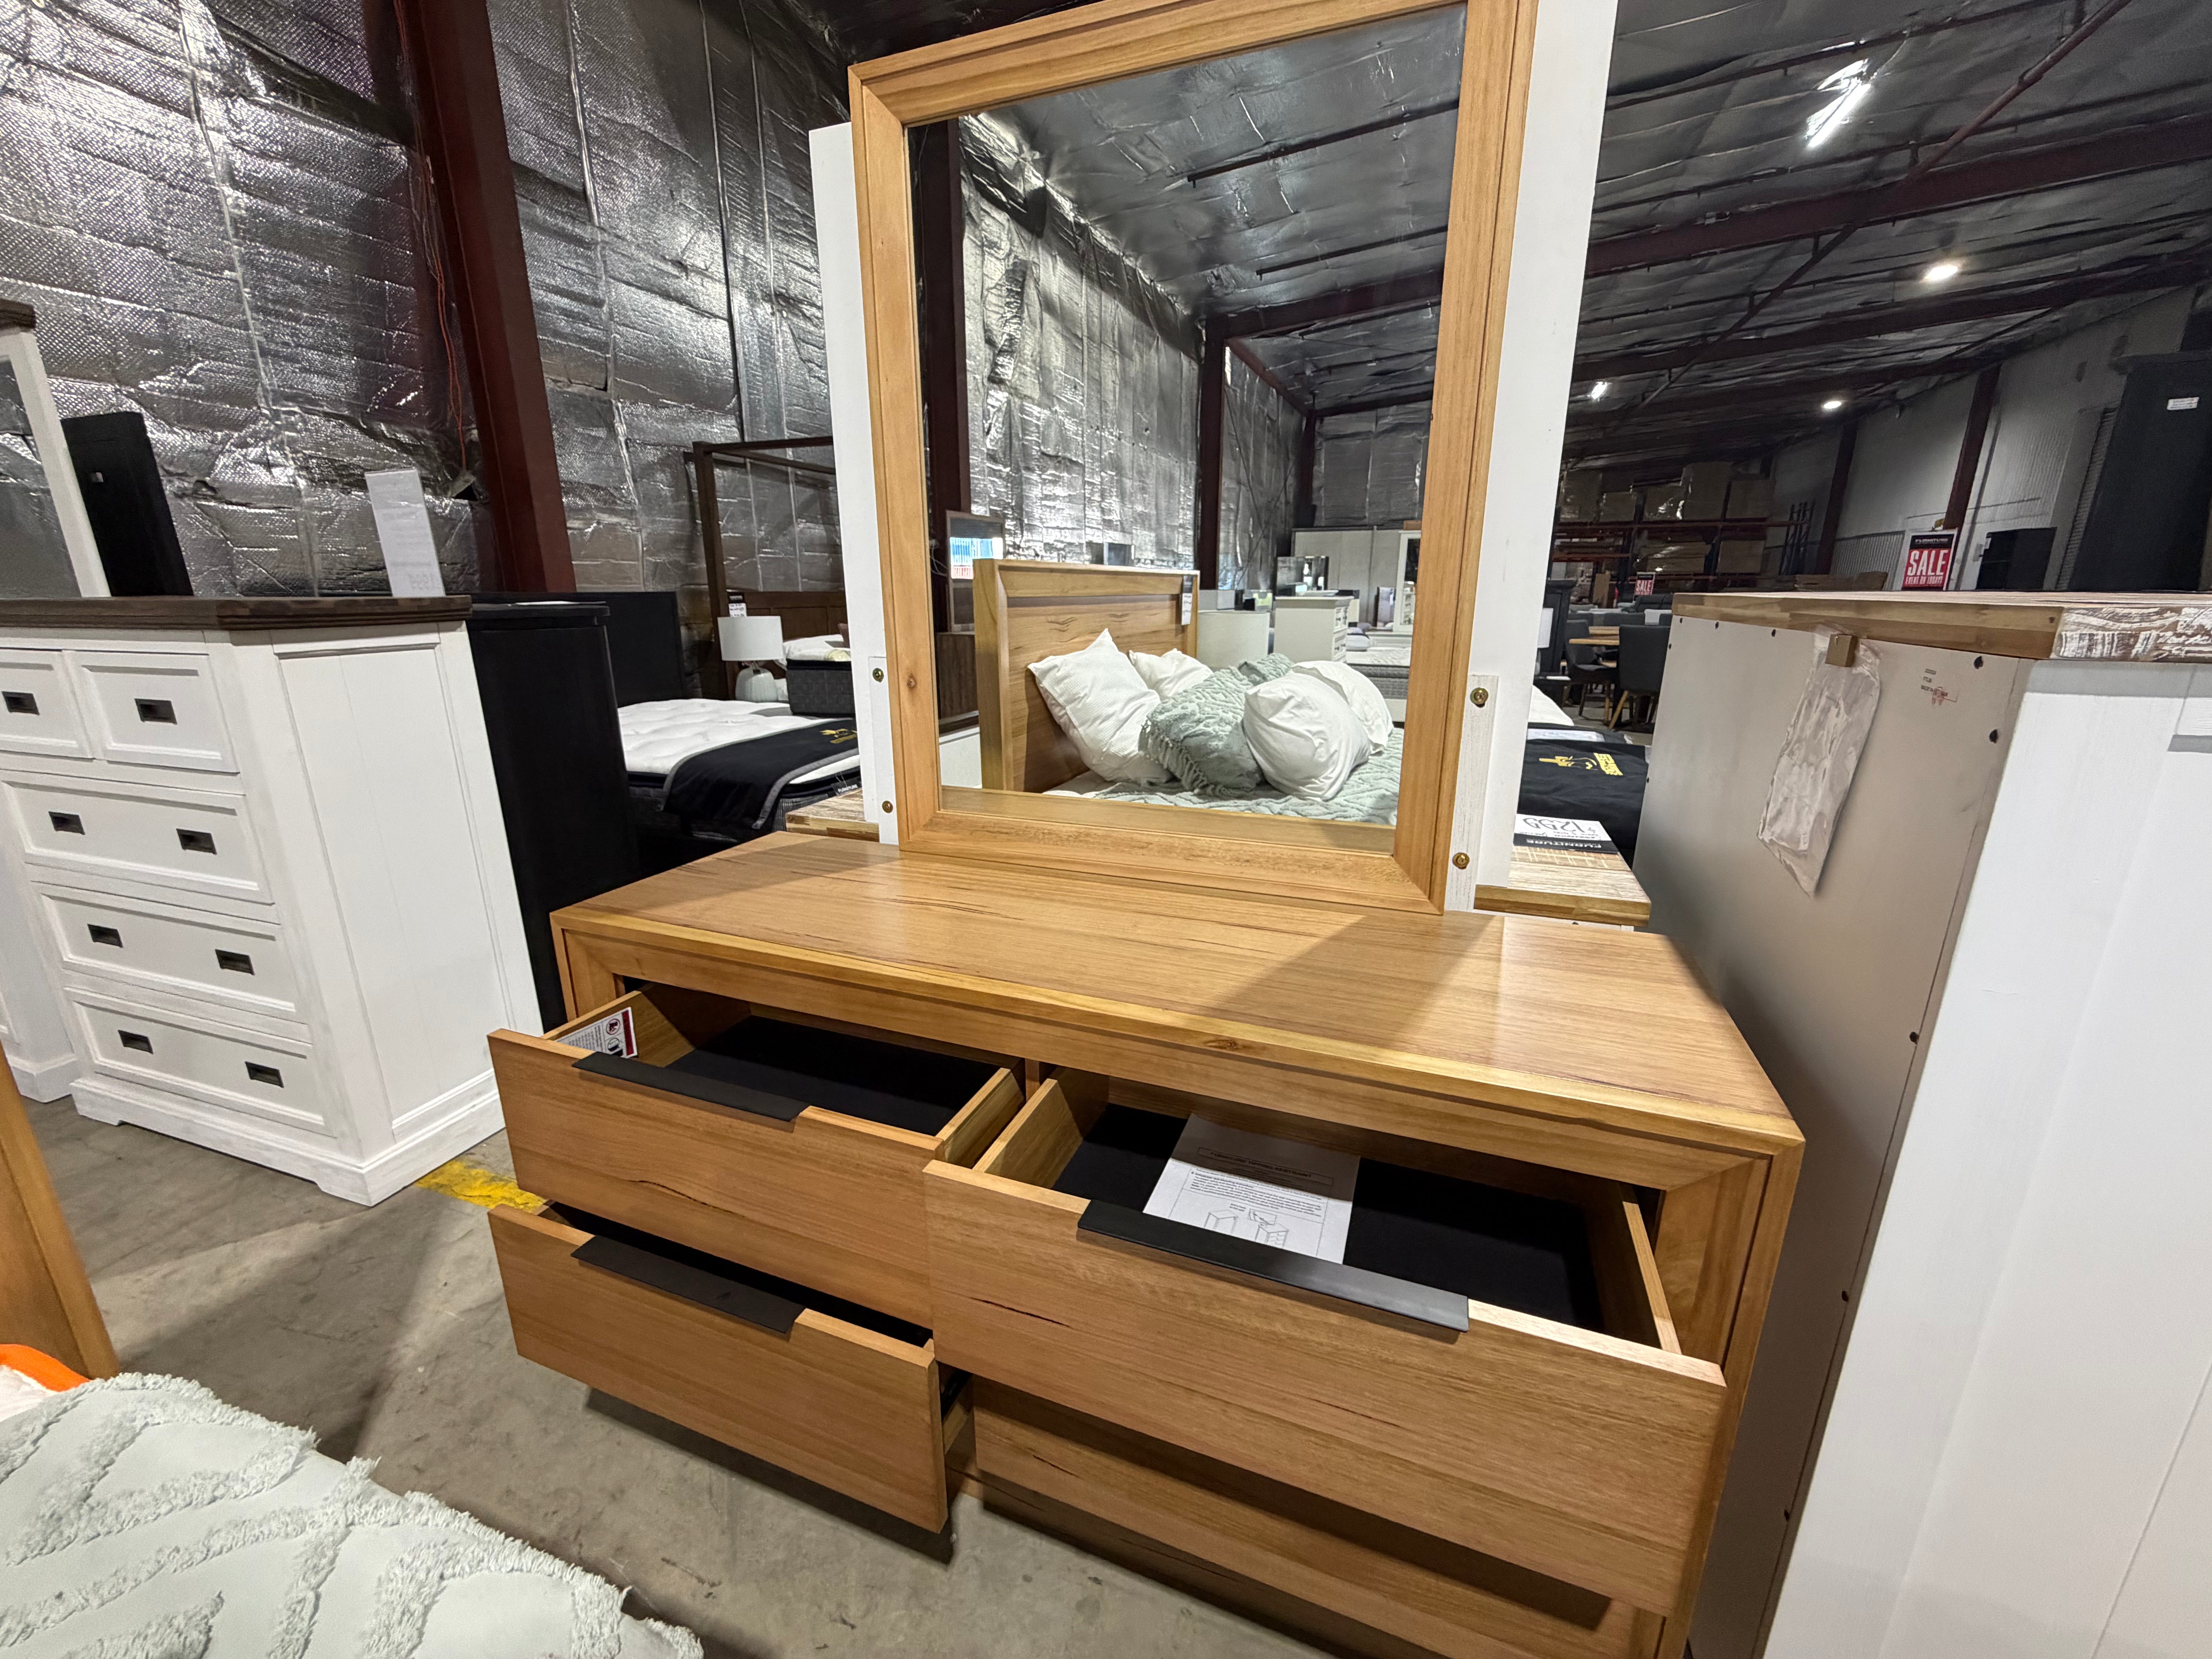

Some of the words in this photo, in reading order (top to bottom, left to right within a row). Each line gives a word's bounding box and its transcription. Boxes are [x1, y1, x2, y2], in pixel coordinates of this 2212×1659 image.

[1907, 550, 1948, 576] SALE
[1636, 580, 1653, 591] SALE
[1526, 839, 1602, 848] FURNITURE
